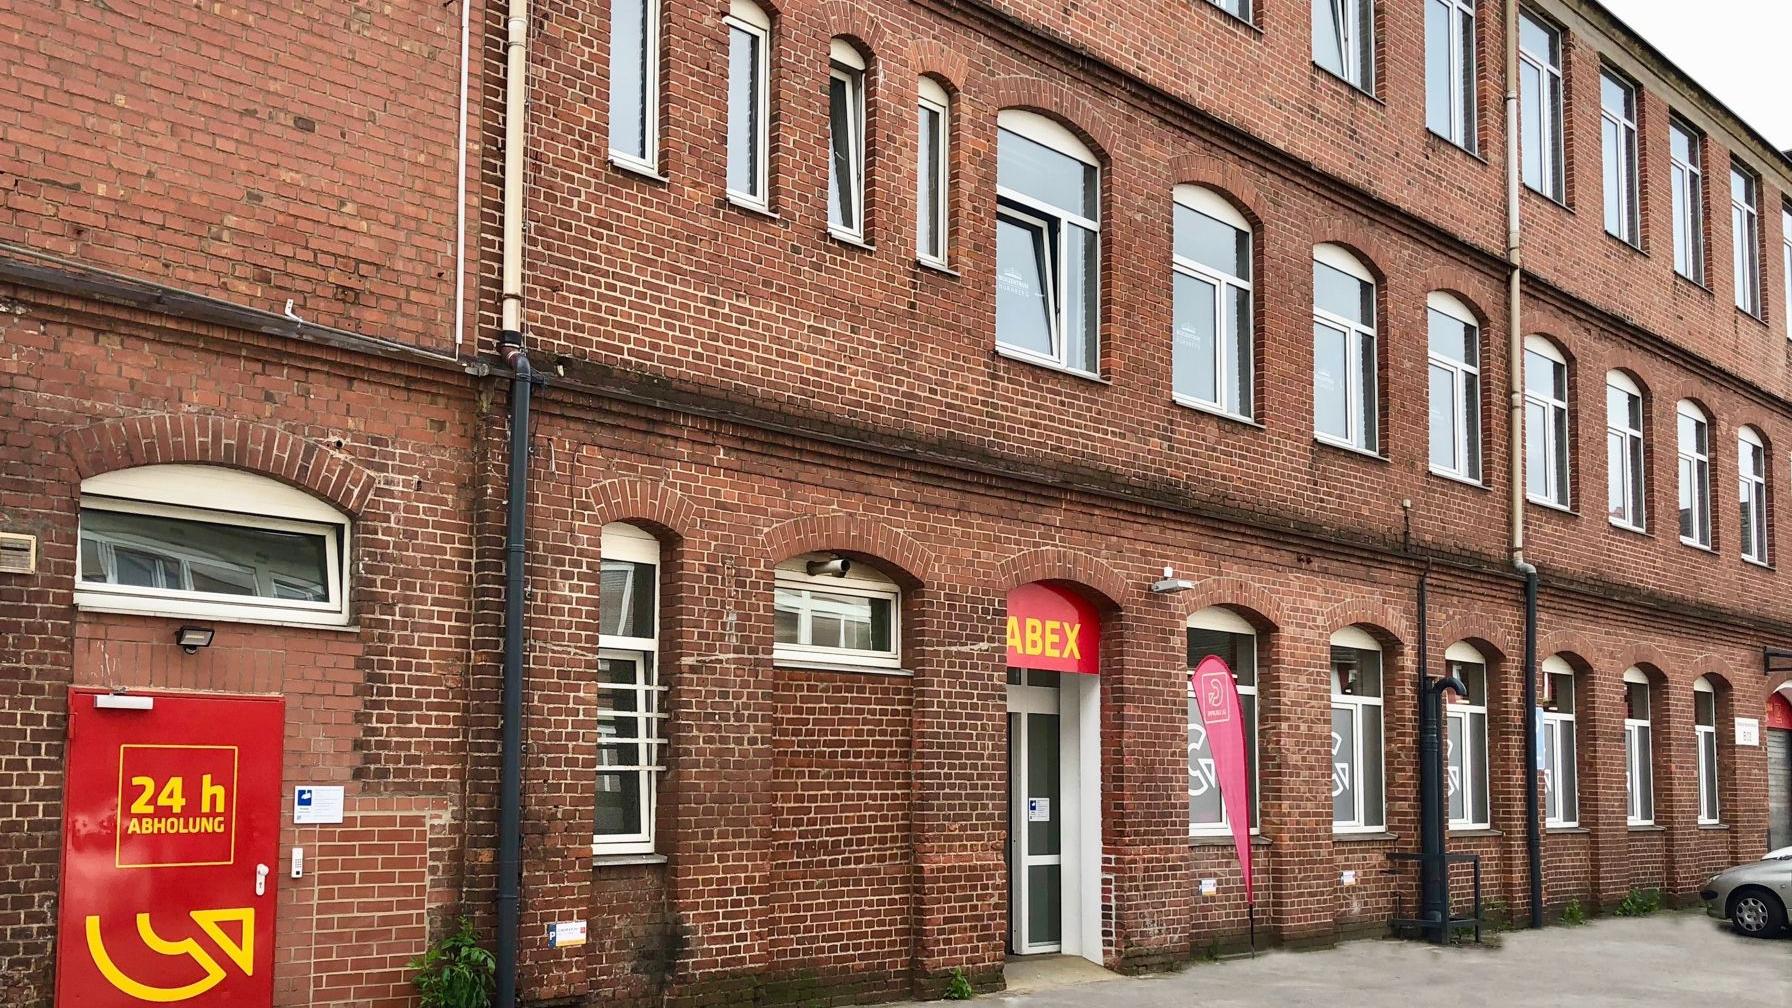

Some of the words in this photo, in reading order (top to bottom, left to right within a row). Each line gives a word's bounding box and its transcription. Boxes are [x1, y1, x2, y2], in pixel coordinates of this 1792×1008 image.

[1007, 616, 1082, 660] ABEX
[130, 776, 186, 814] 24
[201, 773, 225, 813] h
[127, 816, 225, 834] ABHOLUNG
[549, 931, 556, 941] P
